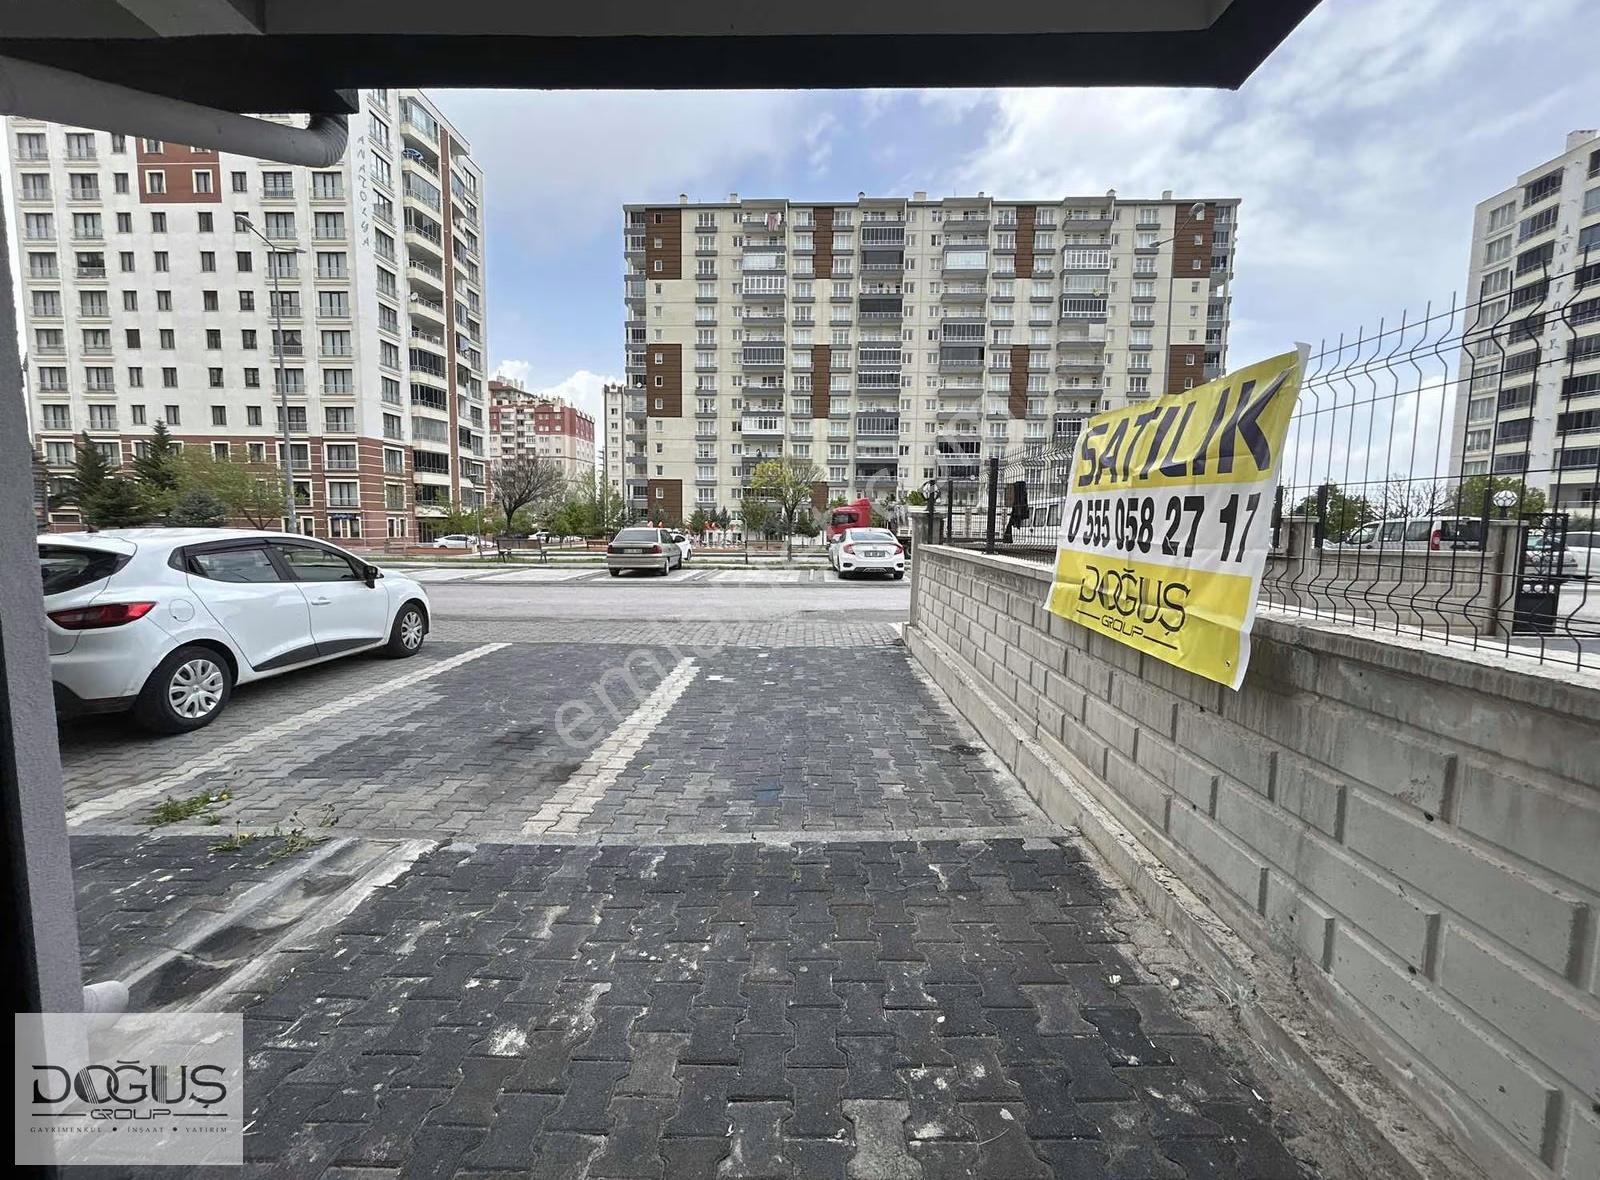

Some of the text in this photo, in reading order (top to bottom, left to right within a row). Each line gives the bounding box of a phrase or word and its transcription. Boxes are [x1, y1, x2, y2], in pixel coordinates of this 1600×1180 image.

[1078, 364, 1296, 488] SATILIK
[1067, 492, 1261, 563] 0 555 058 27 17
[1078, 564, 1191, 636] DOĞUŞ
[1101, 614, 1144, 638] GROUP
